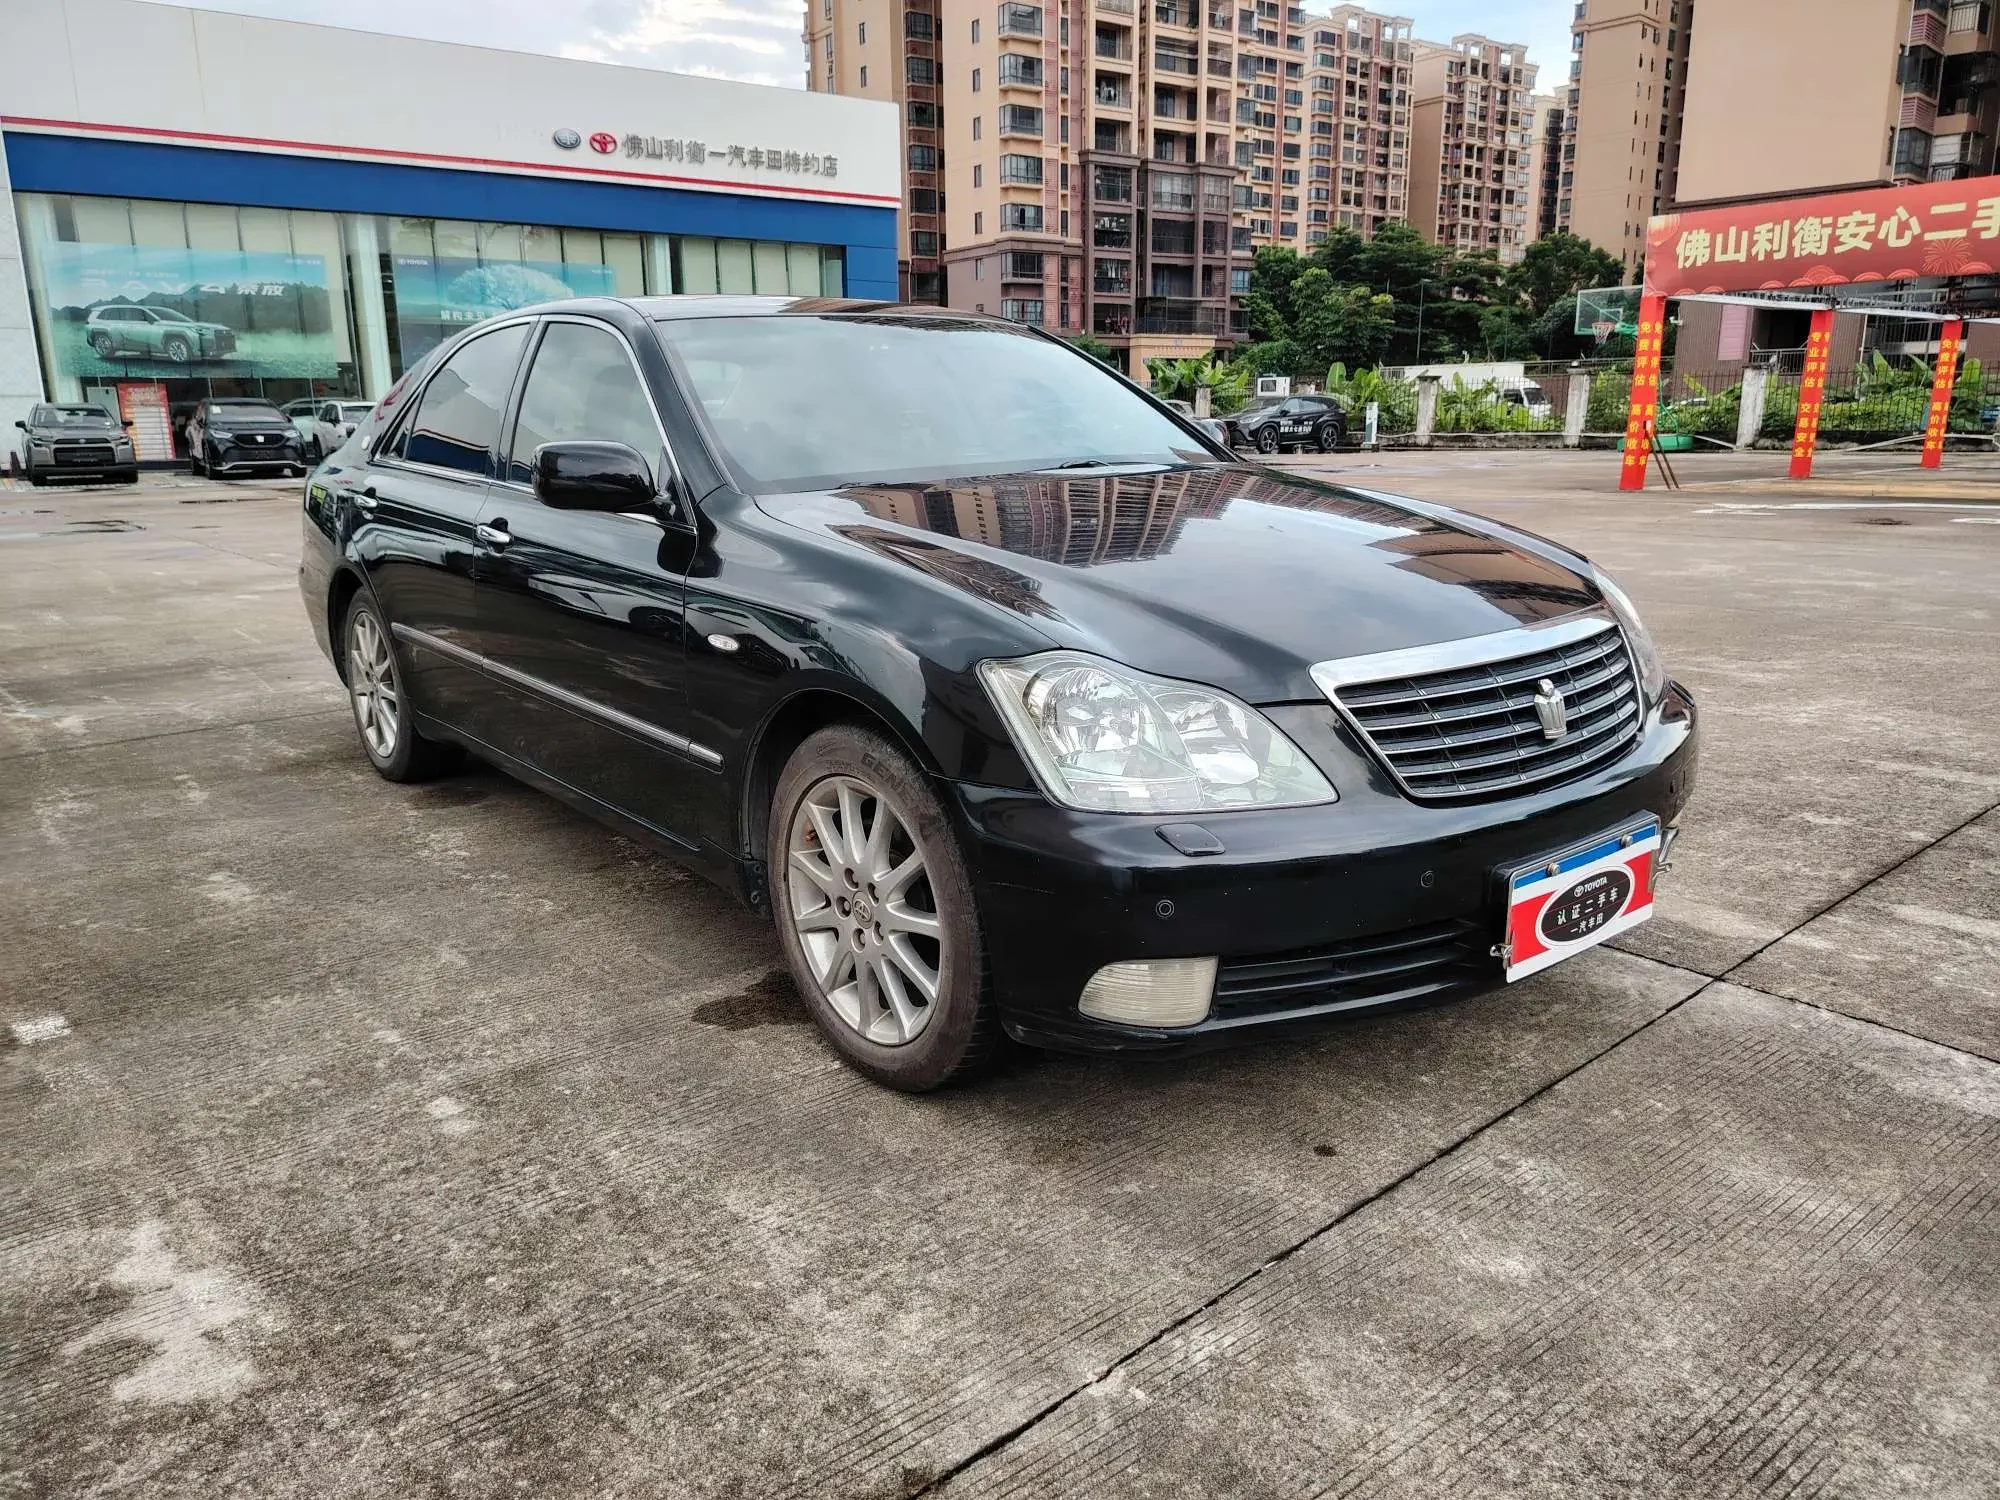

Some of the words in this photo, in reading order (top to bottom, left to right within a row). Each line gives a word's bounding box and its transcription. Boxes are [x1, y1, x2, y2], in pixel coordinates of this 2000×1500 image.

[621, 133, 839, 178] 佛山利衡一汽丰田特约店
[1675, 196, 2000, 269] 佛山利衡安心二手
[1635, 321, 1652, 386] 免费评估
[1624, 403, 1642, 466] 高价收车
[1557, 887, 1619, 925] 认证二手车
[1584, 876, 1608, 892] TOYOTA
[1570, 912, 1604, 933] 一汽丰田
